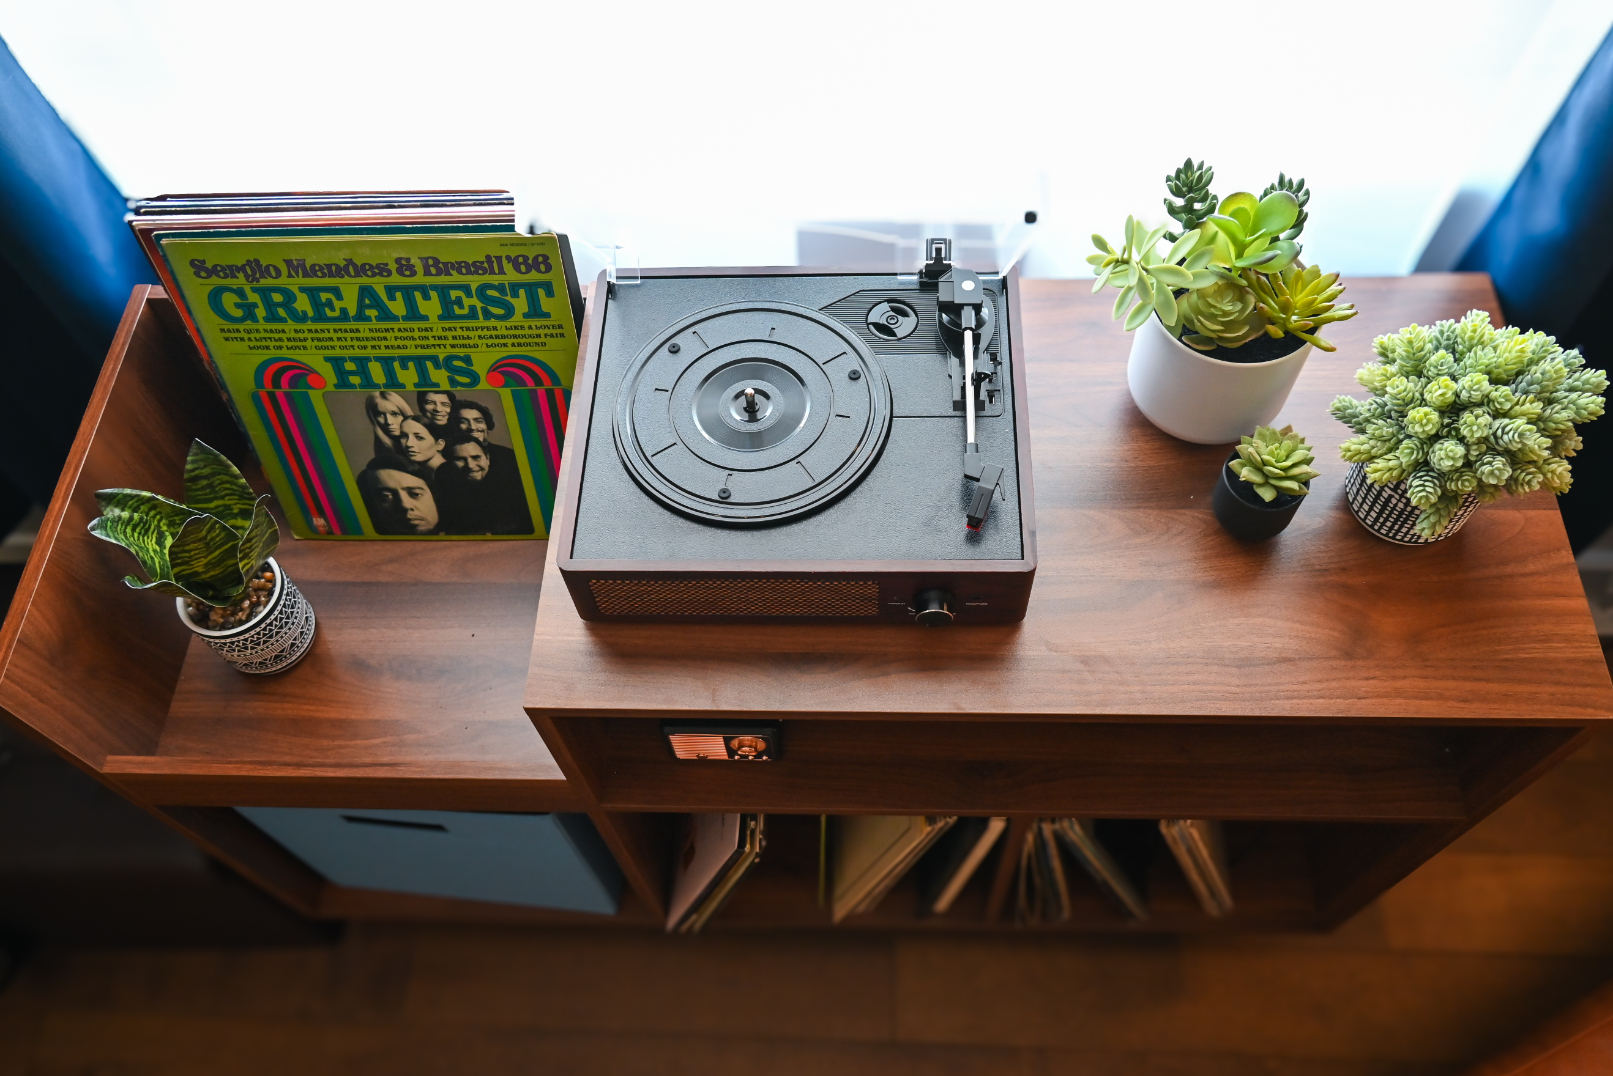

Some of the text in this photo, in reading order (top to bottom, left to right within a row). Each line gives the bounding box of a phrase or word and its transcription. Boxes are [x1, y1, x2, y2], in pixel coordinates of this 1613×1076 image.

[189, 258, 282, 284] Sergio
[282, 258, 392, 278] Mendes
[394, 256, 417, 278] &
[208, 281, 555, 324] GREATEST
[323, 354, 481, 390] HITS
